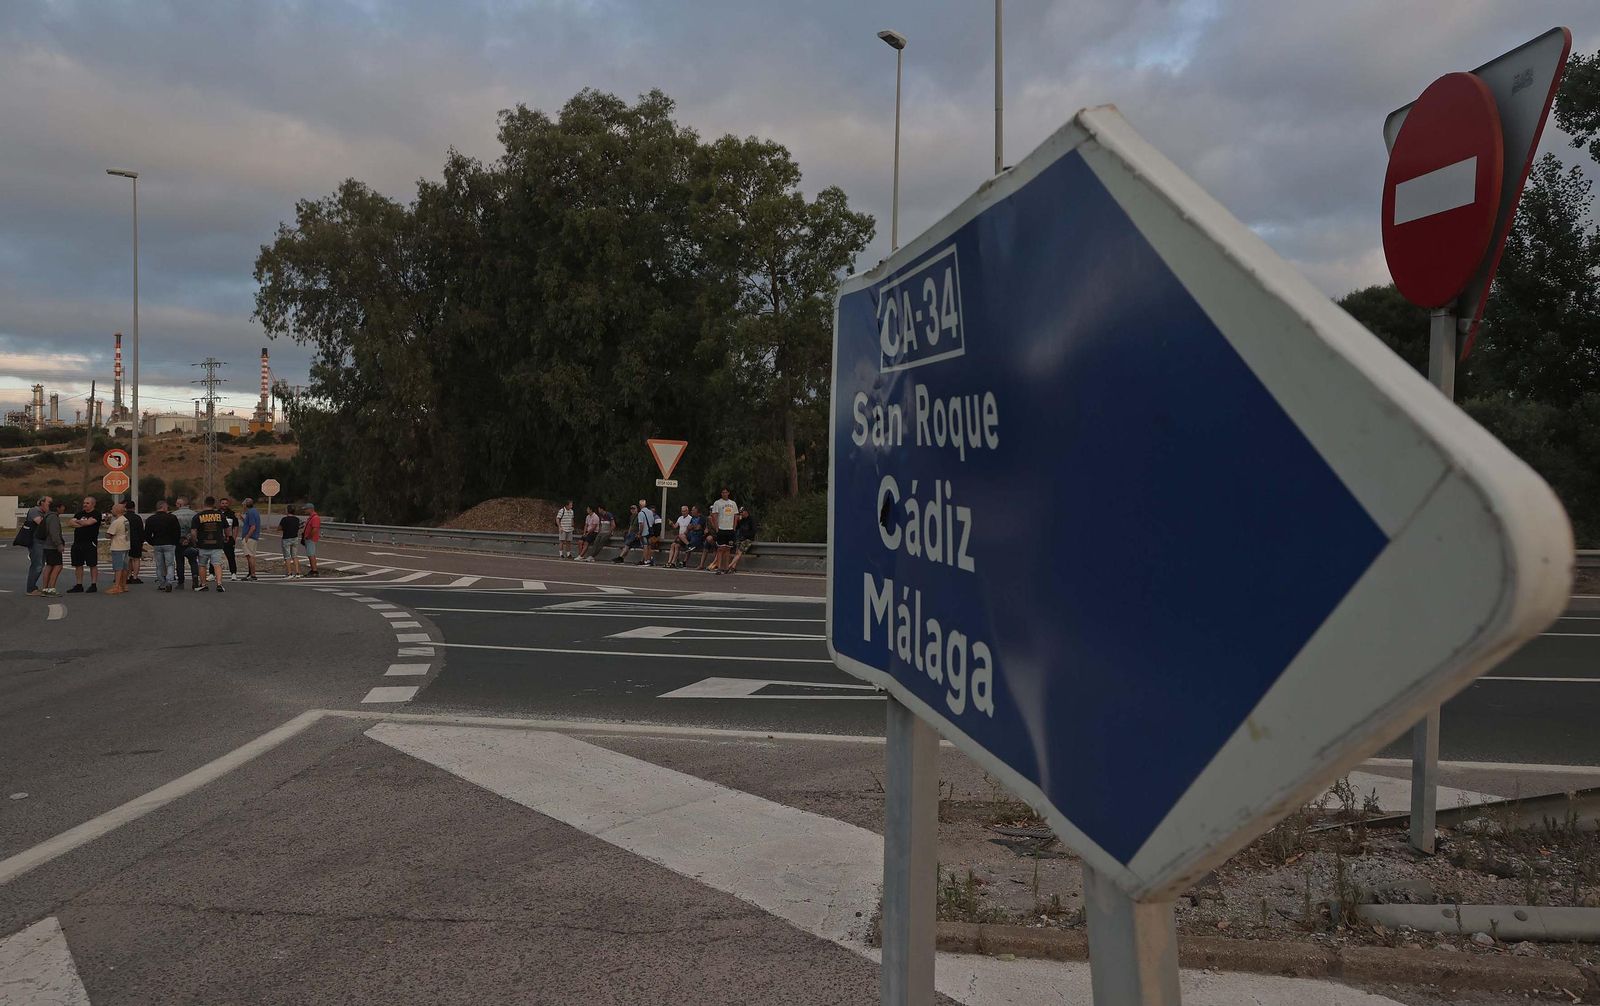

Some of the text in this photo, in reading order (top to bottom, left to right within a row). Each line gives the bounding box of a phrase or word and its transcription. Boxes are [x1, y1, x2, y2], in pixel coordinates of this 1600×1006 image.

[879, 267, 960, 358] CA-34
[852, 384, 999, 462] San Roque
[199, 513, 222, 523] MARVEL
[878, 475, 975, 573] Cádiz
[863, 572, 994, 718] Málaga
